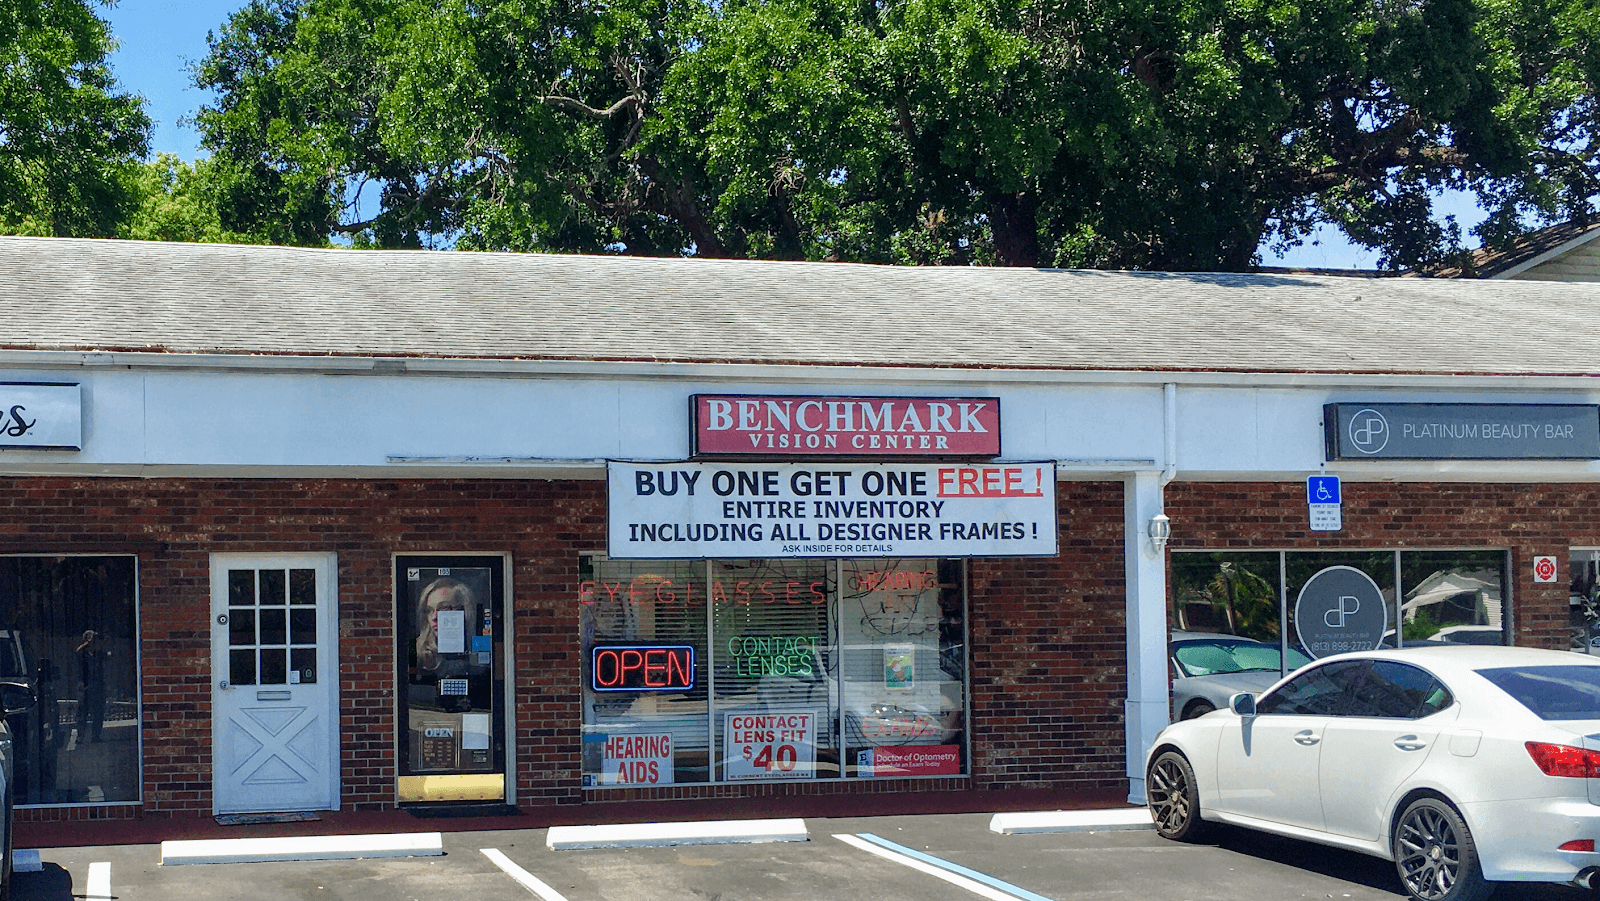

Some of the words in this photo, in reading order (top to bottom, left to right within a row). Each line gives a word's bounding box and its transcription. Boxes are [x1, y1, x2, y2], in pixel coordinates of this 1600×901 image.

[706, 399, 989, 433] BENCHMARK
[748, 433, 838, 449] VISION
[851, 434, 949, 449] CENTER
[1403, 423, 1478, 438] PLATINUM
[1482, 424, 1541, 439] BEAUTY
[1544, 424, 1575, 439] BAR
[635, 470, 702, 497] BUY
[711, 470, 780, 497] ONE
[790, 470, 852, 497] GET
[861, 470, 927, 497] ONE
[937, 468, 1024, 497] FREE
[722, 500, 807, 519] ENTIRE
[813, 500, 945, 519] INVENTORY
[628, 522, 763, 542] INCLUDING
[770, 523, 811, 541] ALL
[818, 522, 934, 541] DESIGNER
[939, 522, 1025, 541] FRAMES
[782, 544, 801, 553] ASK
[803, 544, 832, 553] INSIDE
[834, 544, 853, 553] FOR
[855, 544, 893, 552] DETAILS
[858, 569, 936, 591] HEARING
[580, 580, 826, 604] EYEGLASSES
[728, 636, 819, 656] CONTACT
[1311, 642, 1330, 652] (813)
[596, 650, 690, 686] OPEN
[736, 655, 812, 676] LENSES
[732, 716, 809, 729] CONTACT
[734, 730, 776, 743] LENS
[781, 730, 807, 742] FIT
[604, 735, 670, 759] HEARING
[876, 754, 902, 762] Doctor
[913, 753, 956, 762] Optometry
[616, 761, 659, 784] AIDS
